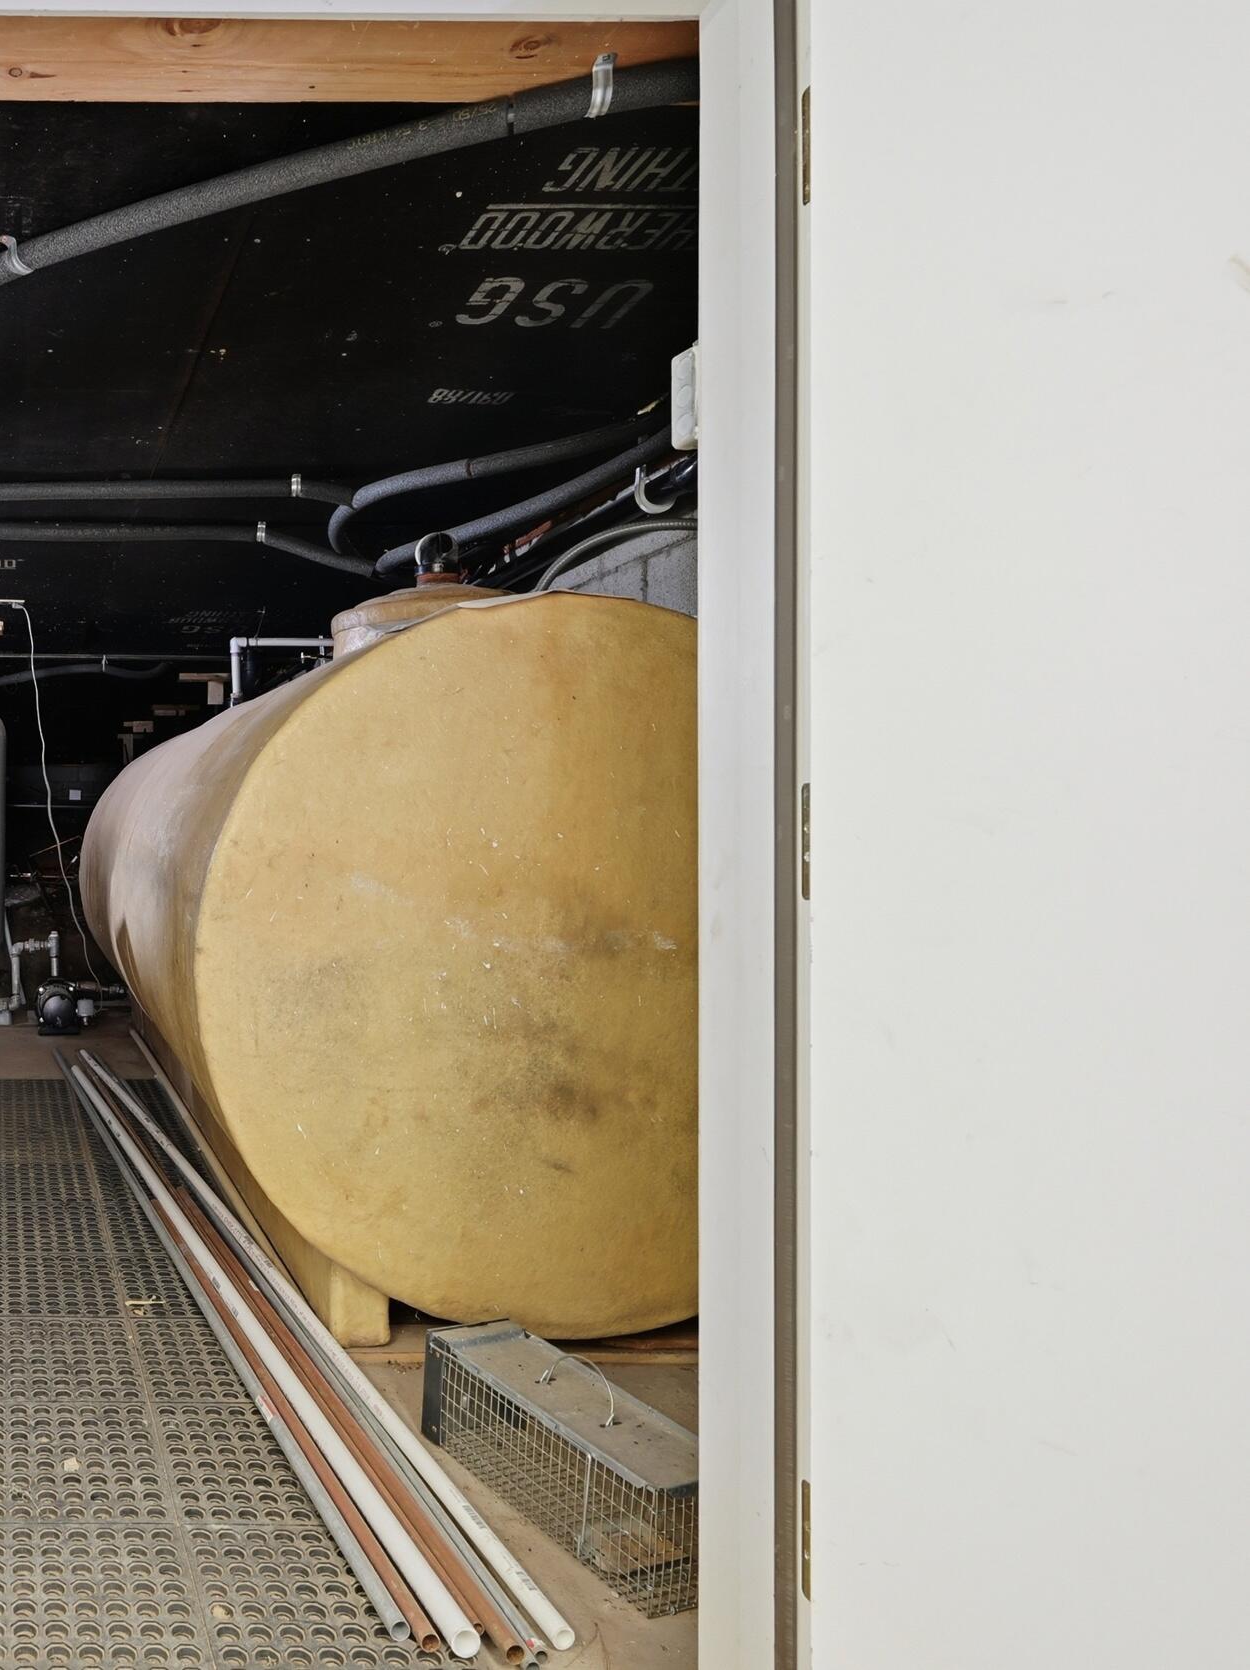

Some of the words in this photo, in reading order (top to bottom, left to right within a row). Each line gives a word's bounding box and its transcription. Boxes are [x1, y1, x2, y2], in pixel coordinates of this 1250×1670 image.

[542, 147, 697, 193] THING
[457, 211, 696, 250] HERWOOD
[455, 277, 655, 329] USG
